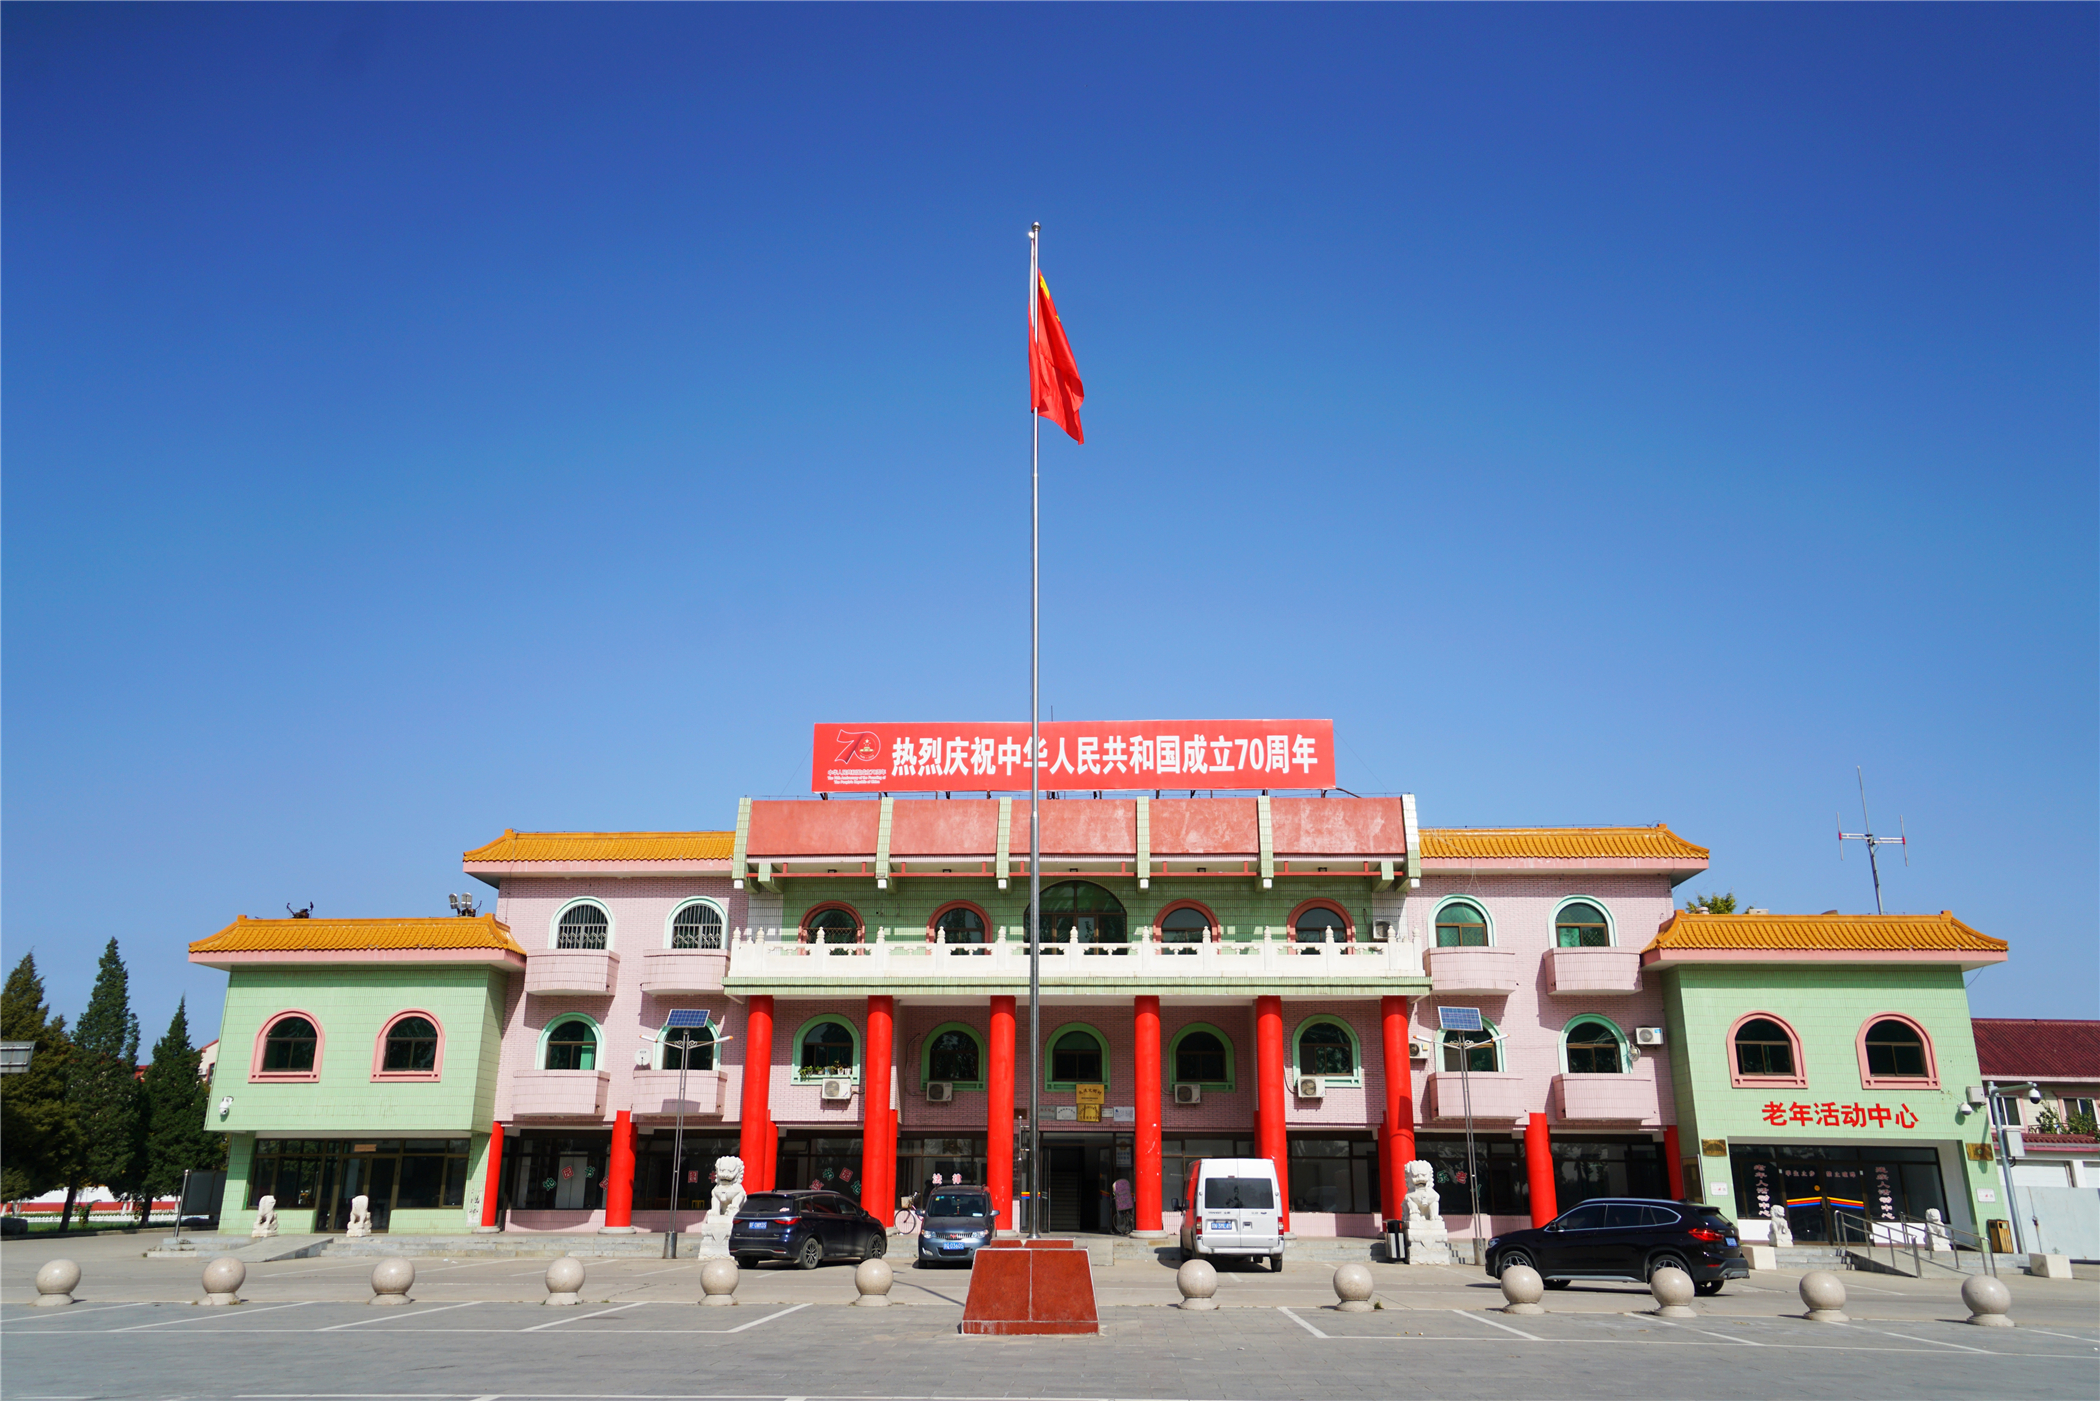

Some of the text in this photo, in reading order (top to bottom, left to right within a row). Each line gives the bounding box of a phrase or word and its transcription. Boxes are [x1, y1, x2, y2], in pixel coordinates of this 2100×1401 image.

[891, 734, 1318, 776] 热烈庆祝中华人民共和国成立70周年
[1761, 1101, 1919, 1129] 老年活动中心
